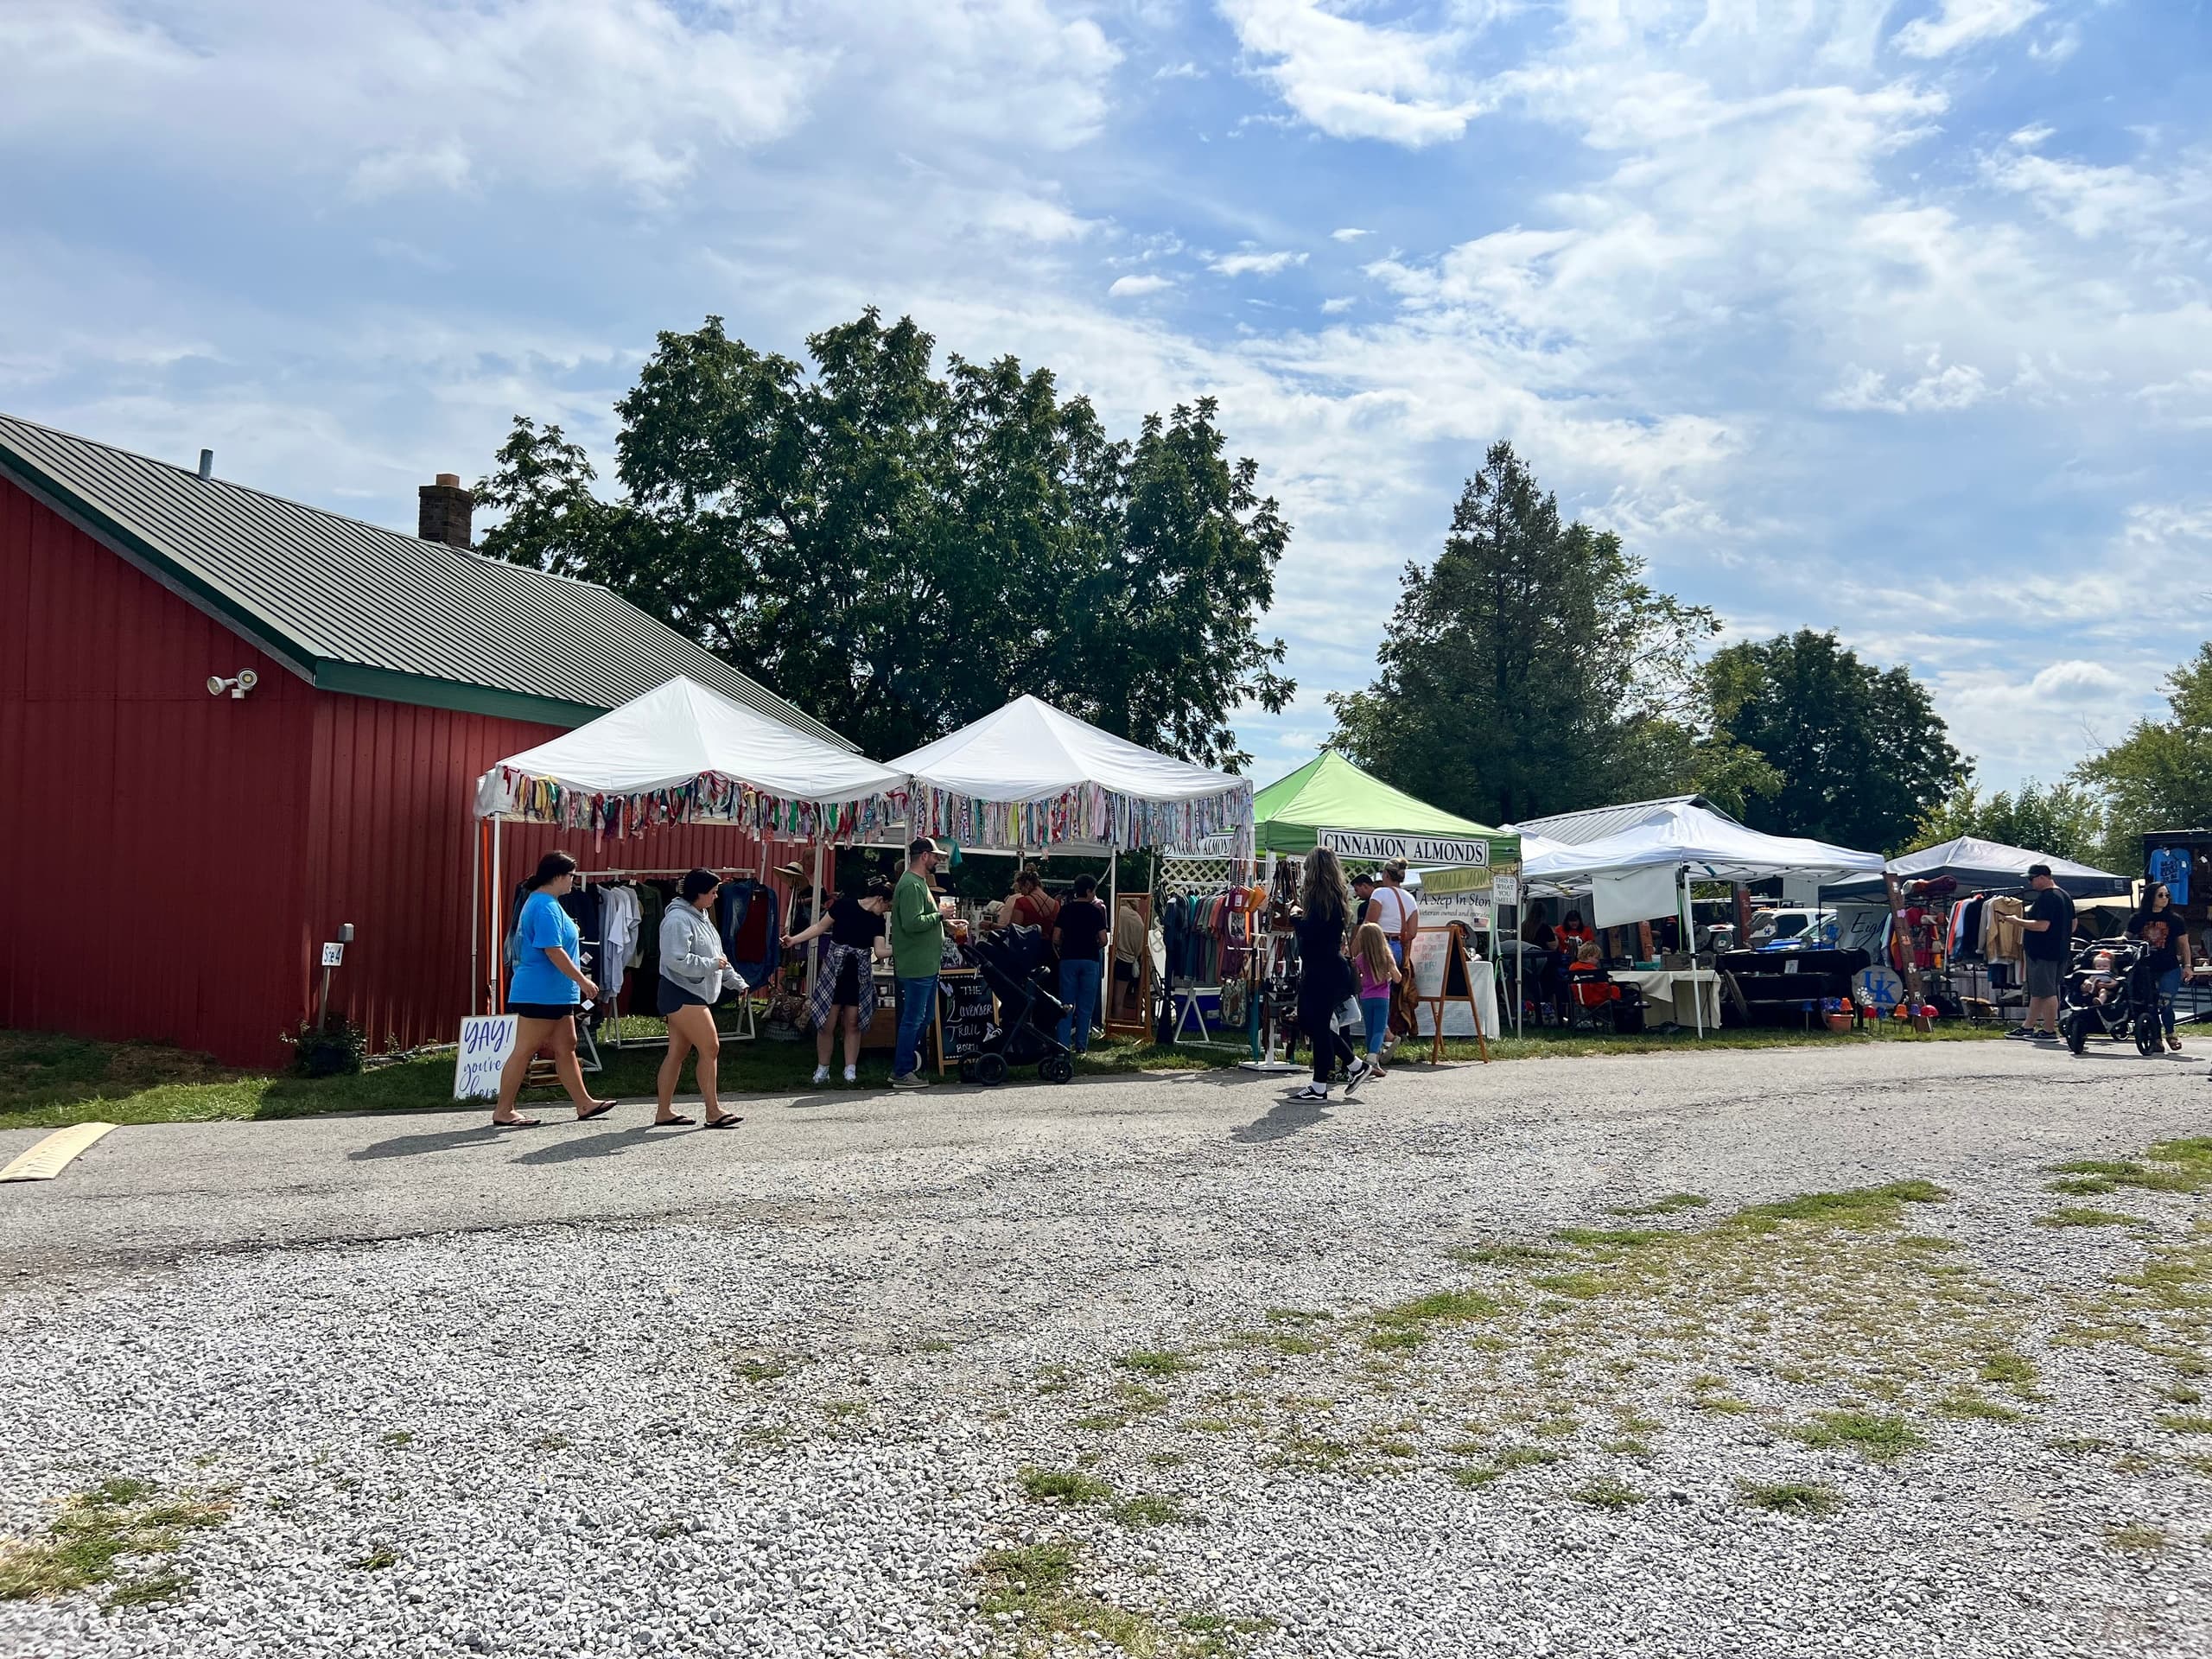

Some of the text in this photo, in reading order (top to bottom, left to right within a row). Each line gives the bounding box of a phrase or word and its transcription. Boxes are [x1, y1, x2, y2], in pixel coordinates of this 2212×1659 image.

[1325, 834, 1483, 862] CINNAMON ALMONDS
[1420, 893, 1428, 905] A
[1456, 893, 1466, 906] In
[1469, 893, 1491, 907] Ston
[336, 946, 341, 963] 4
[960, 985, 982, 995] THE
[1863, 970, 1897, 1004] UK
[464, 1020, 513, 1054] YAY!
[459, 1057, 502, 1091] you're
